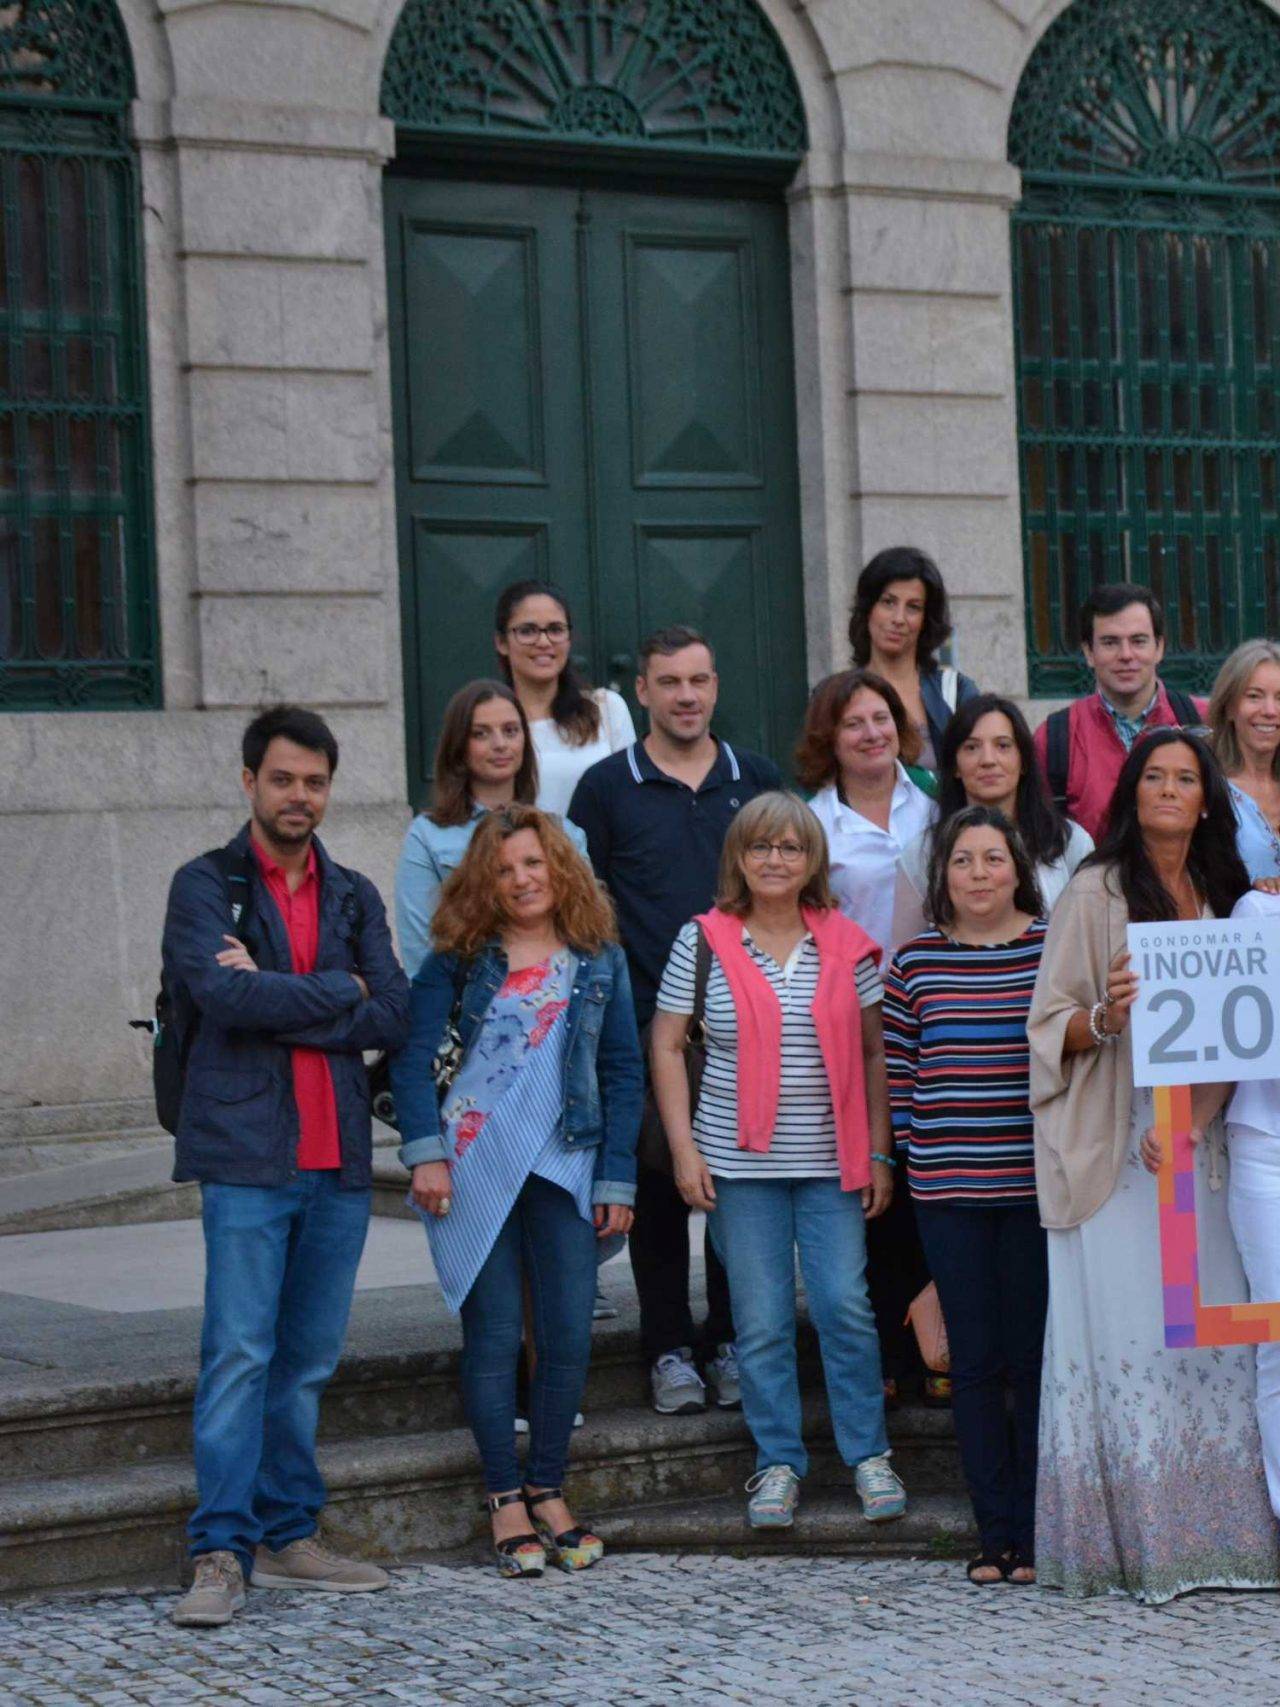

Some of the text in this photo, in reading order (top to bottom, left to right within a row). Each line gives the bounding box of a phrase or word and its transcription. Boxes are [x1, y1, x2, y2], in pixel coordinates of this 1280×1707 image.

[1140, 931, 1263, 948] GONDOMAR A
[1143, 947, 1268, 980] INOVAR
[1147, 984, 1274, 1064] 2.0
